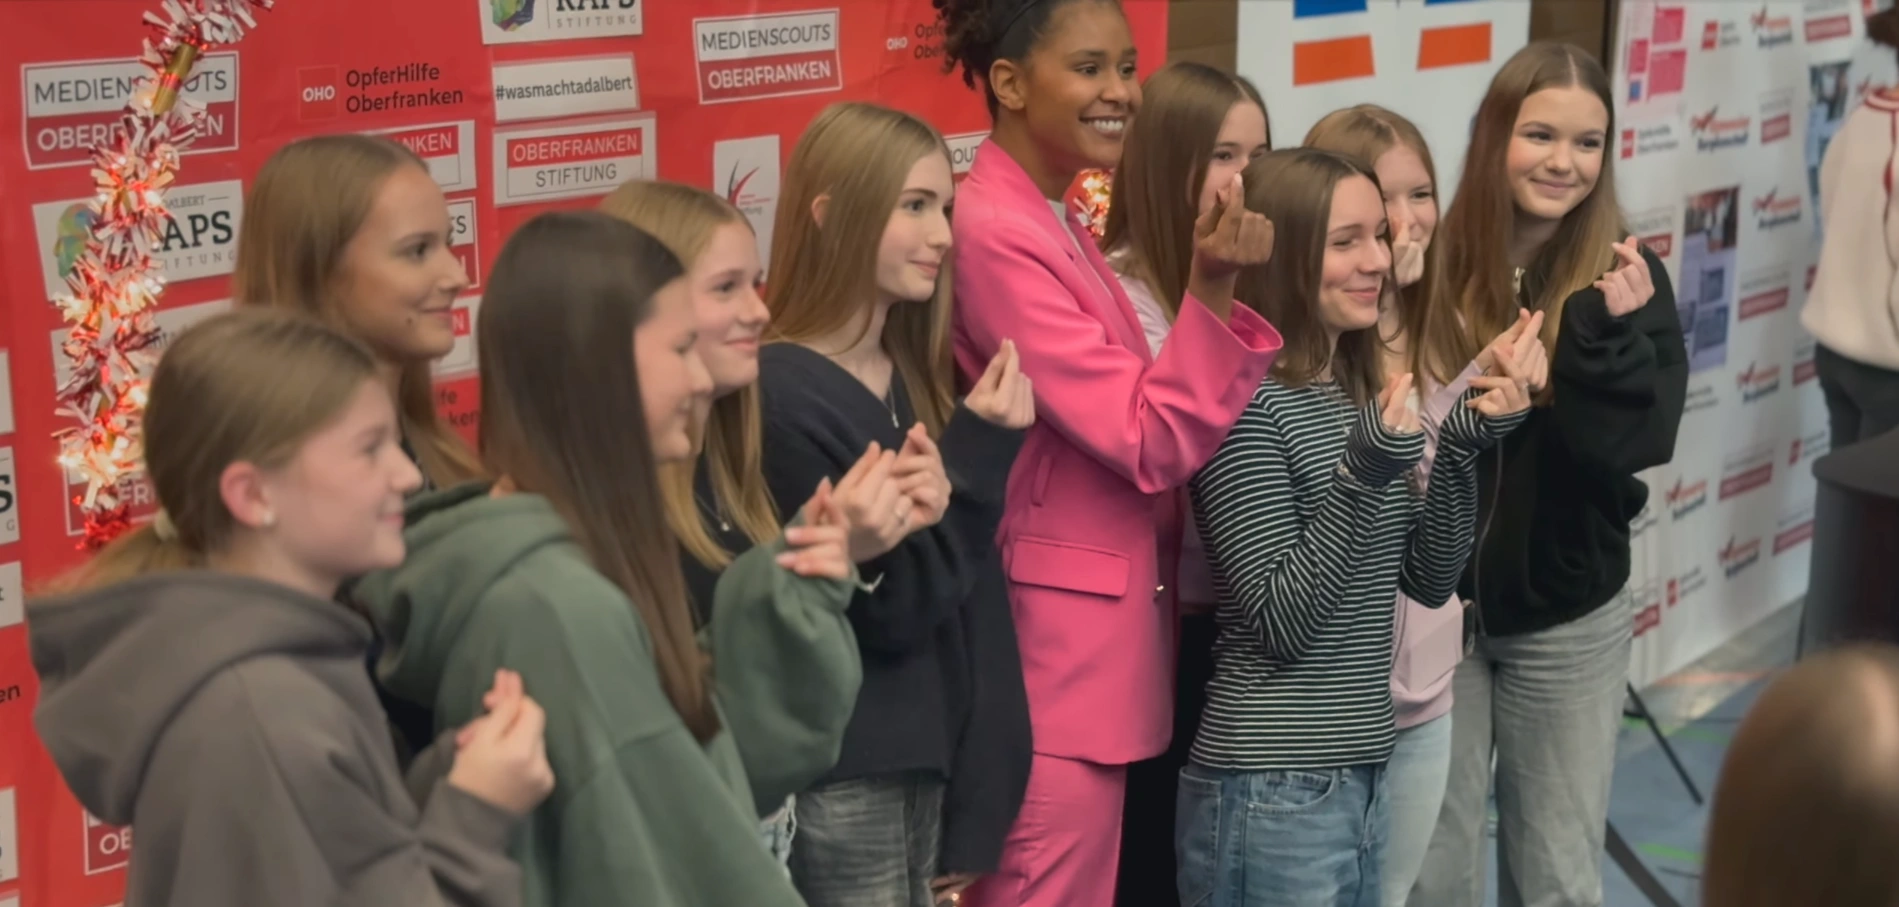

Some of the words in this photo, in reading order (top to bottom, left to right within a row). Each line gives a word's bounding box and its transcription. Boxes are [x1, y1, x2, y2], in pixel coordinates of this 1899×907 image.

[556, 14, 637, 29] STIFTUNG
[701, 23, 832, 51] MEDIENSCOUTS
[34, 70, 228, 104] MEDIENUTS
[346, 62, 441, 91] OpferHilfe
[495, 76, 633, 101] #wasmachtadalbert
[707, 60, 832, 90] OBERFRANKEN
[302, 85, 336, 103] OHO
[345, 87, 464, 113] Oberfranken
[37, 114, 225, 152] OBERFEN
[512, 133, 638, 162] OBERFRANKEN
[535, 163, 617, 188] STIFTUNG
[163, 194, 206, 209] ALBERT
[153, 210, 234, 252] APS
[163, 249, 236, 272] IFTUN
